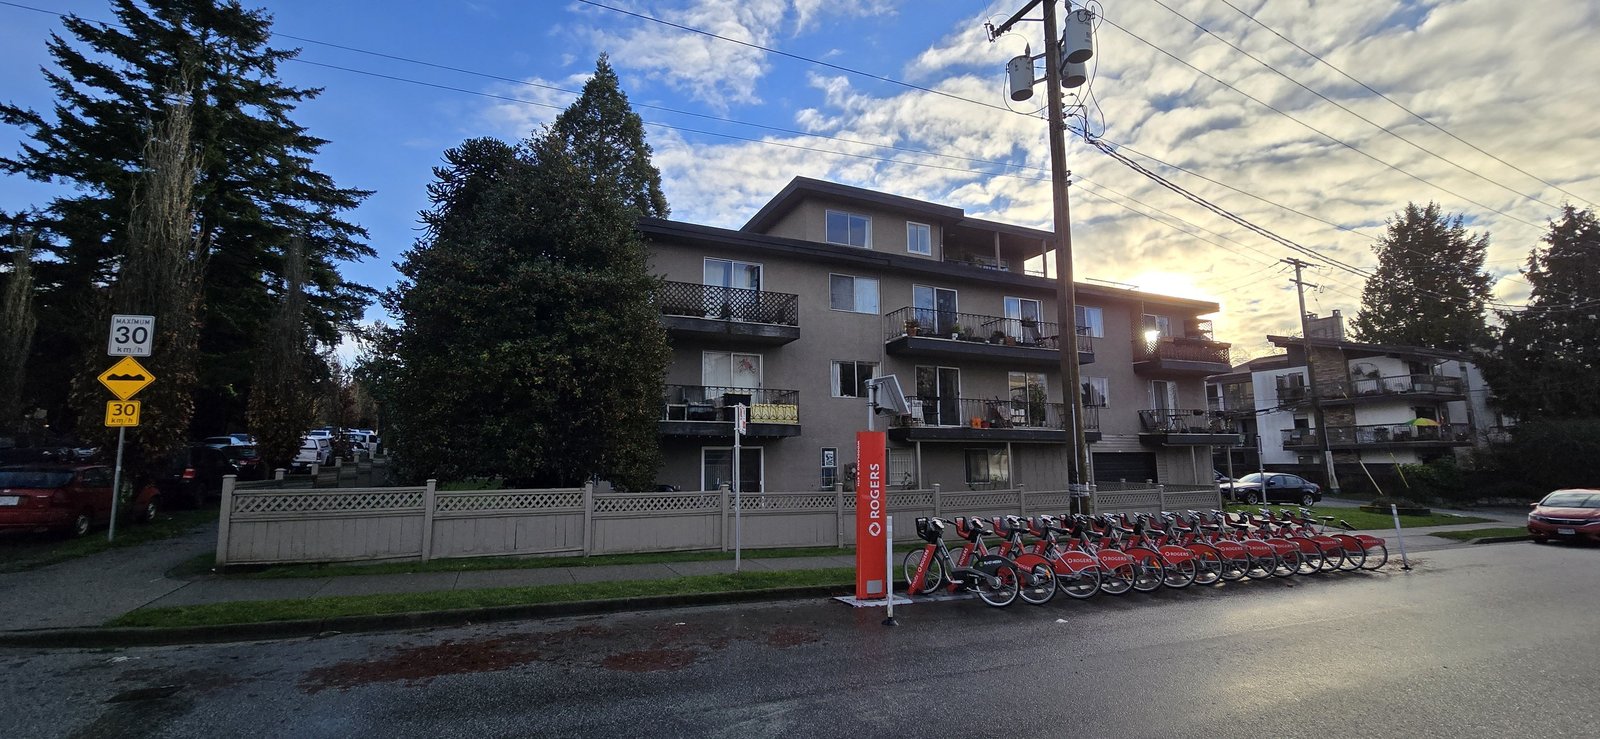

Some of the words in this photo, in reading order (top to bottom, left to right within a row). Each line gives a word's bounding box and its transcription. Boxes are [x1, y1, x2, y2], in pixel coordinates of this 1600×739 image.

[115, 326, 148, 344] 30
[112, 404, 136, 417] 30
[869, 463, 881, 519] ROGERS
